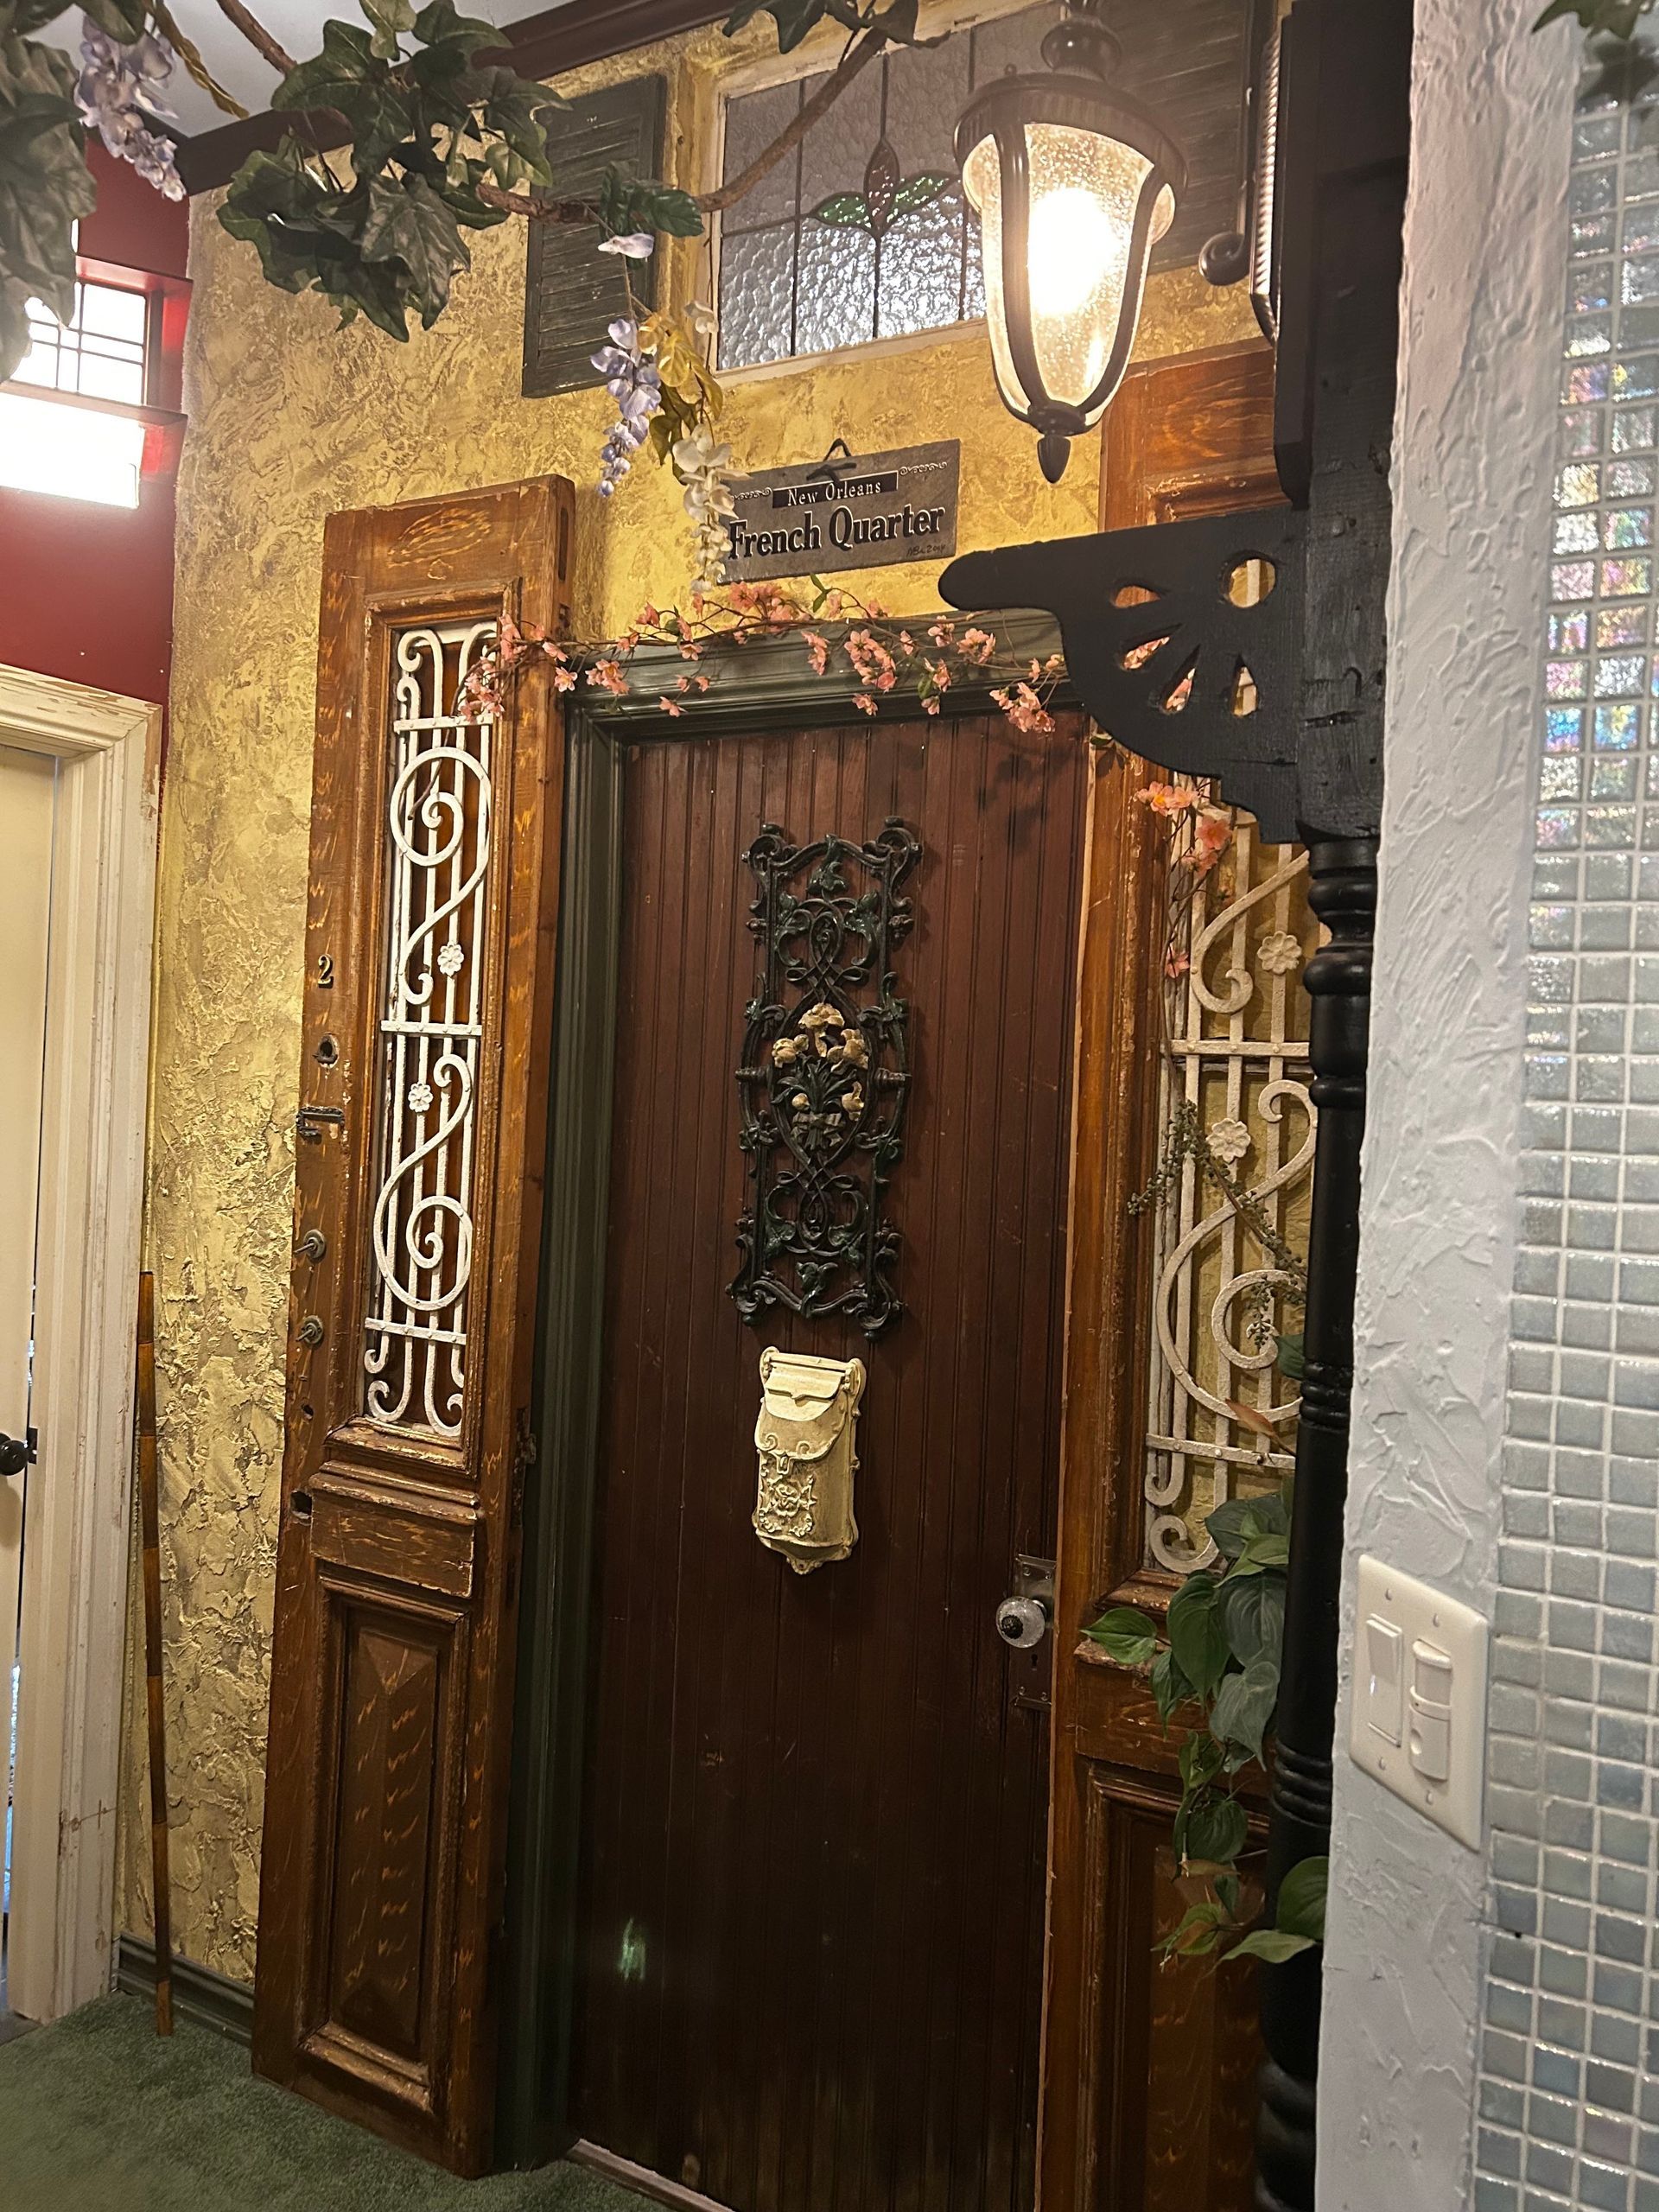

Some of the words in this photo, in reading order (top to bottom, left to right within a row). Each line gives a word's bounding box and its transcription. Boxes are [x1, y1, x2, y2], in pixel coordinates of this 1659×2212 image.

[787, 489, 818, 506] New
[824, 480, 882, 501] Orleans
[728, 511, 822, 560] French
[829, 504, 945, 551] Quarter
[318, 954, 334, 988] 2
